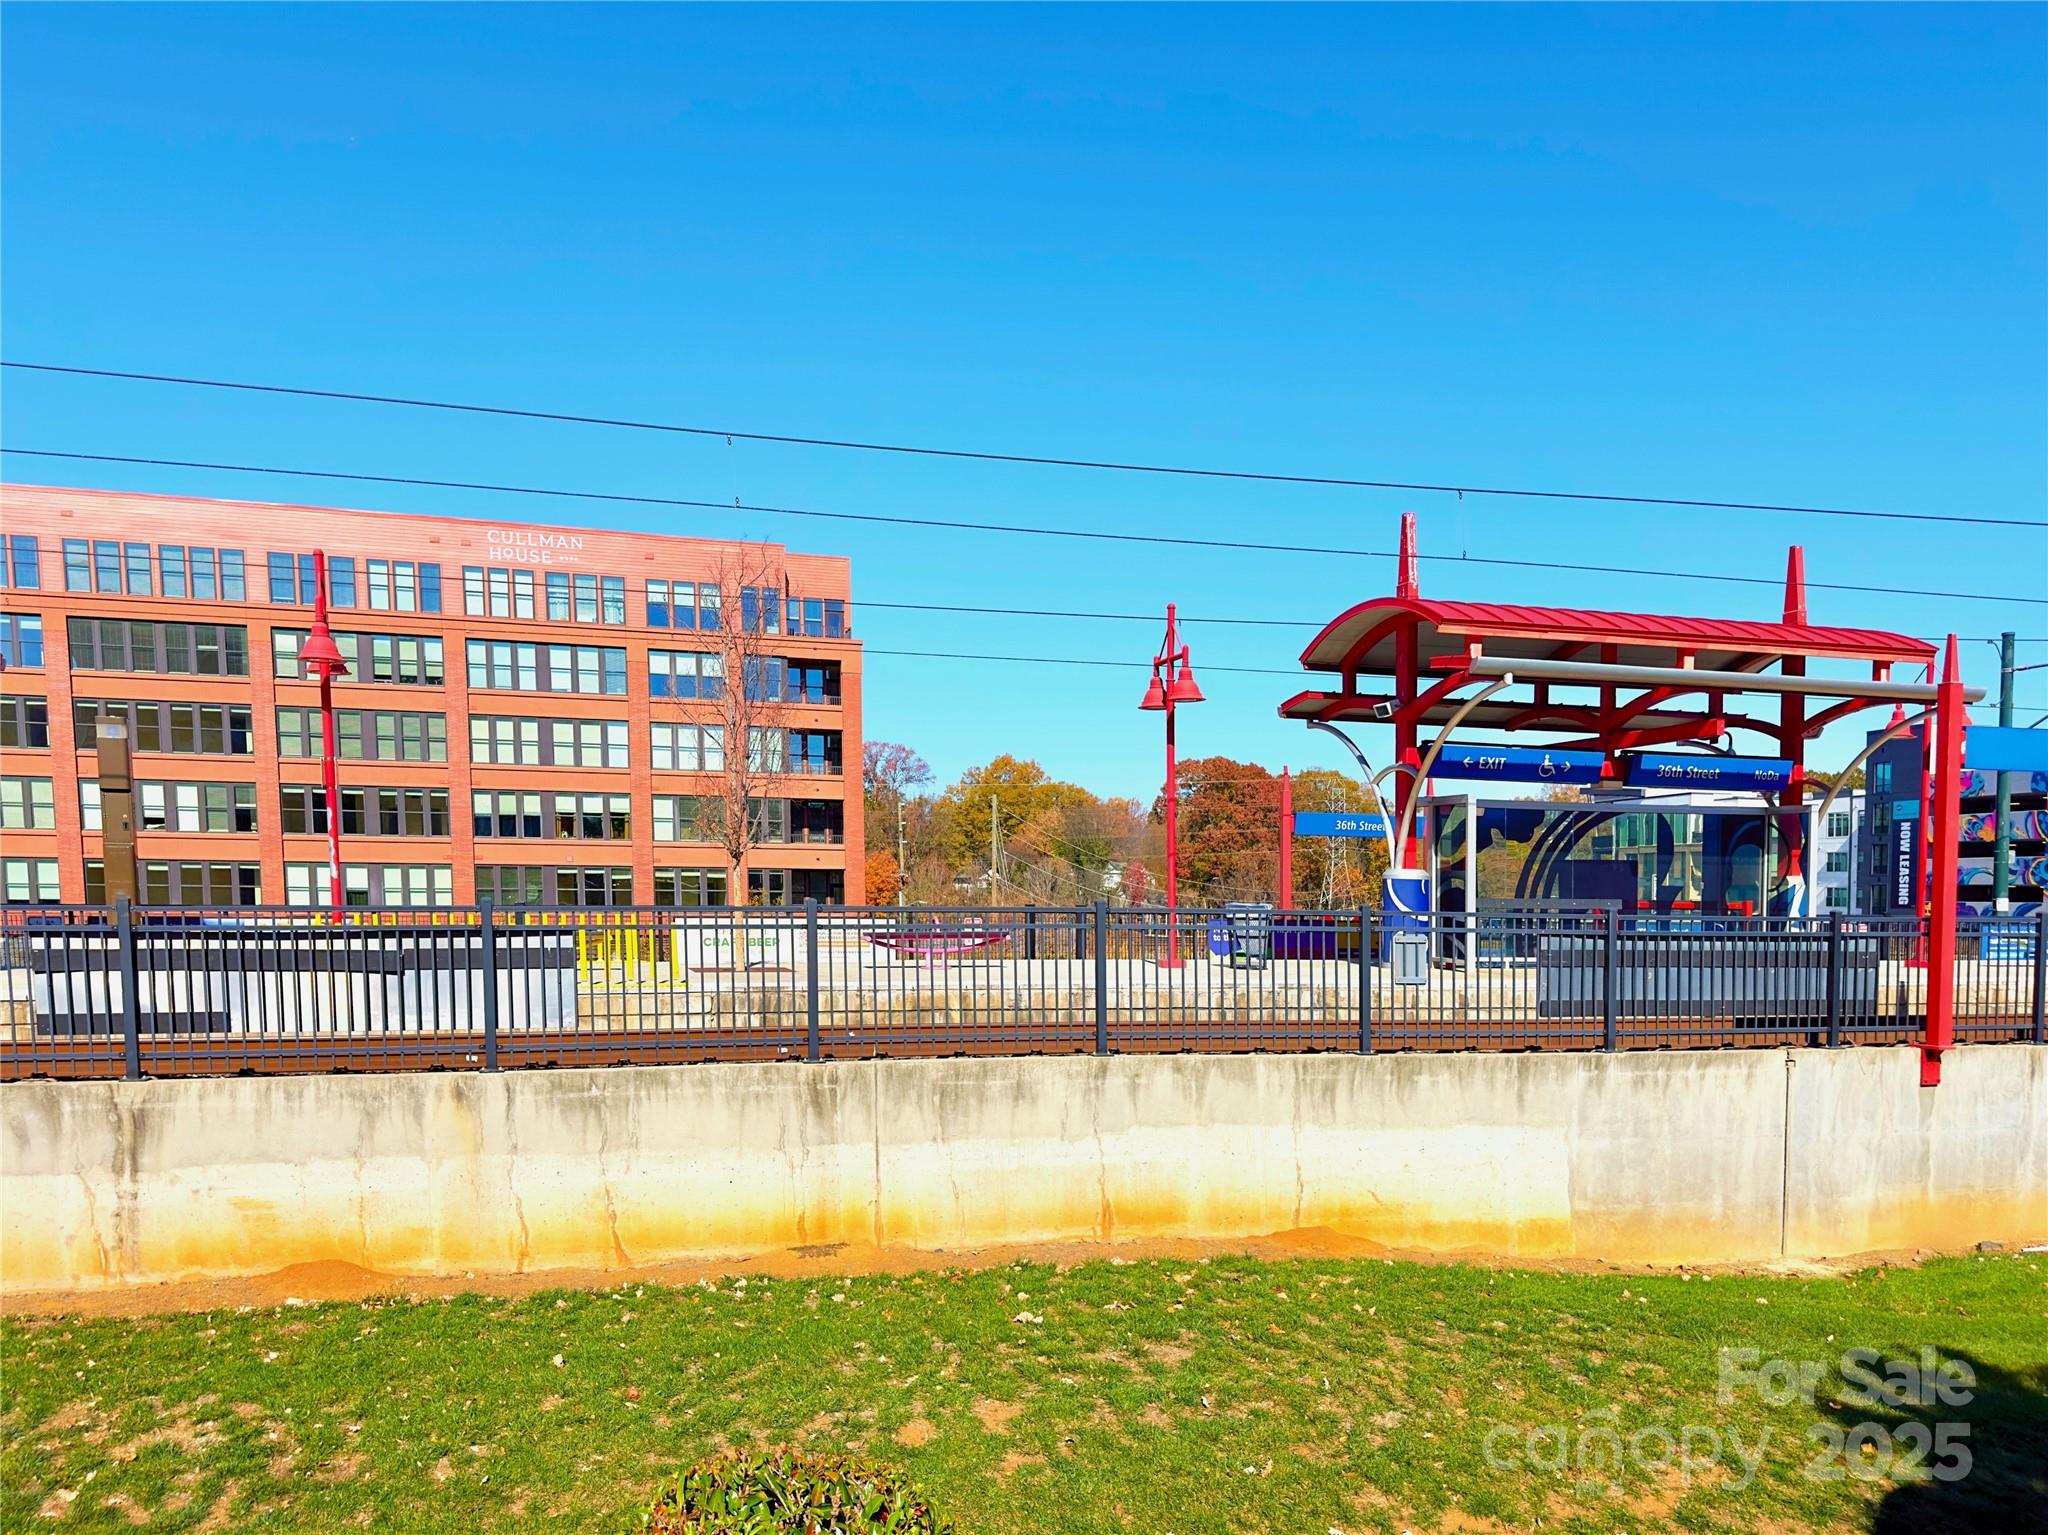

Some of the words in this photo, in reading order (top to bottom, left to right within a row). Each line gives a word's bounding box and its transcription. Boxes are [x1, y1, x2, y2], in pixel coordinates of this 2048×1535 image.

[487, 529, 583, 550] CULLMAN
[489, 547, 552, 564] HOUSE
[1478, 756, 1507, 770] EXIT
[1657, 764, 1683, 778] 36th
[1686, 766, 1720, 779] Street
[1755, 770, 1779, 781] NoDa
[1335, 820, 1356, 830] 36th
[1900, 822, 1911, 852] NOW
[1898, 854, 1910, 905] LEASING
